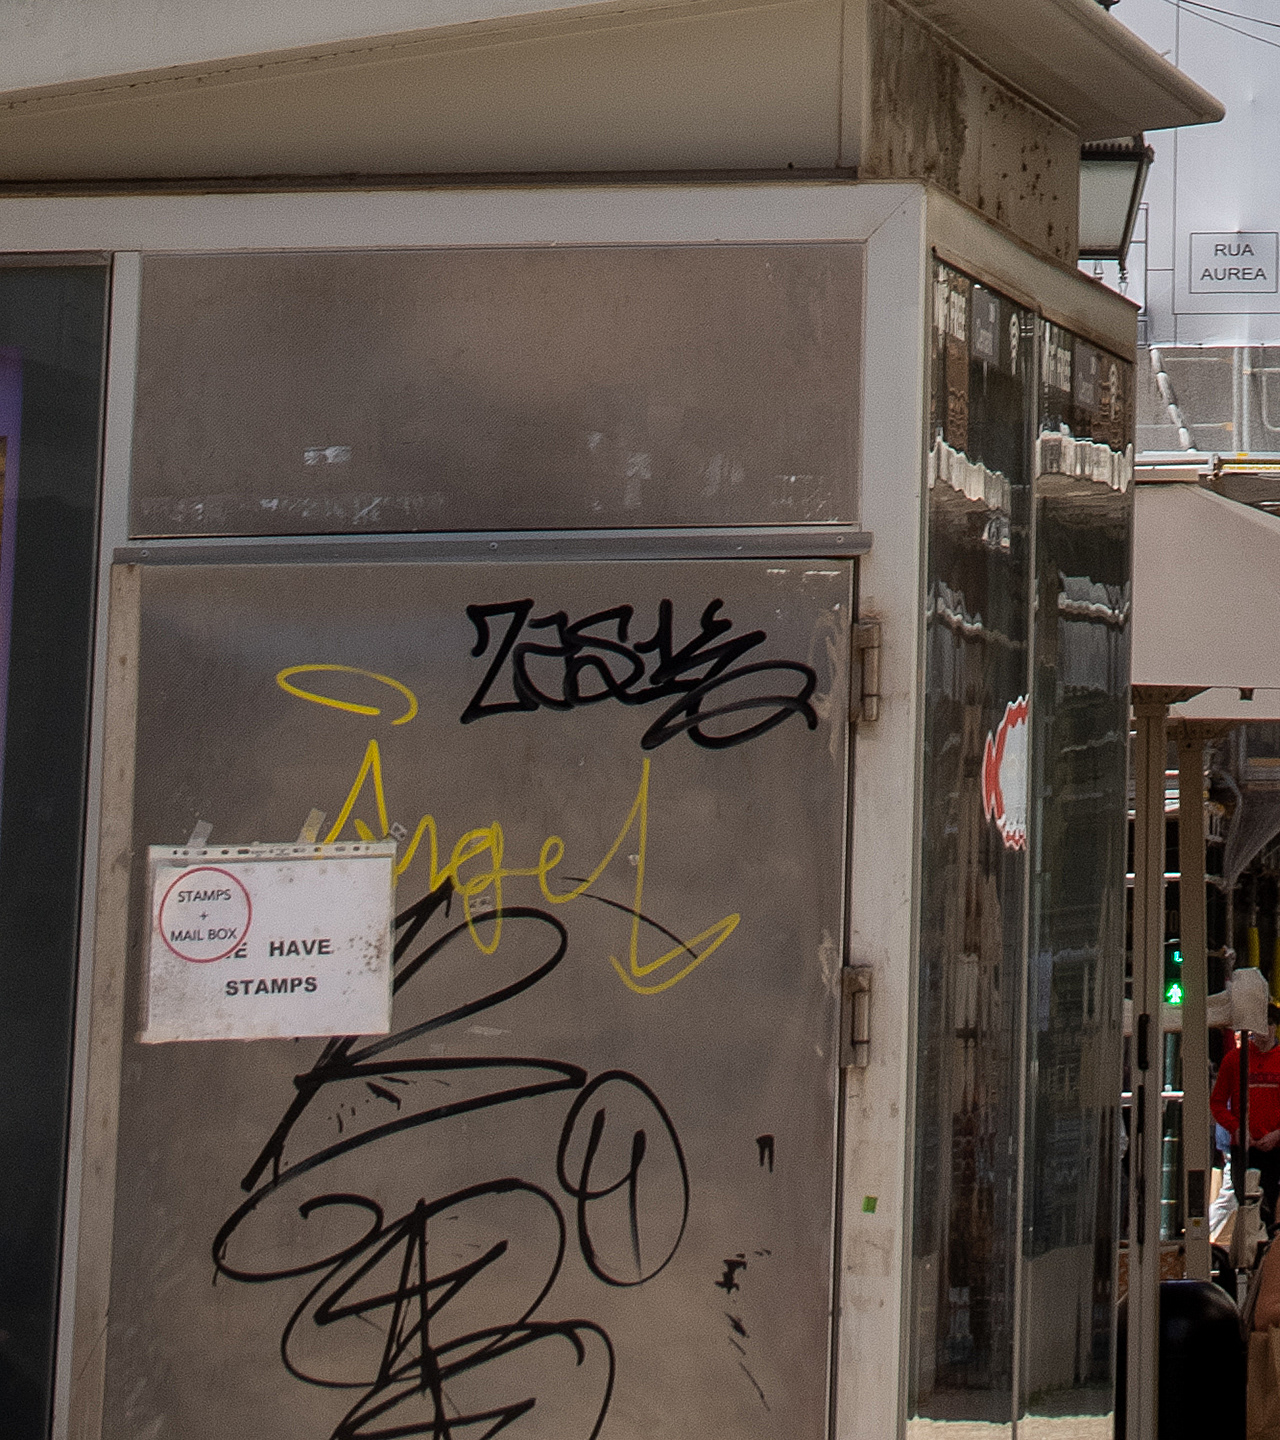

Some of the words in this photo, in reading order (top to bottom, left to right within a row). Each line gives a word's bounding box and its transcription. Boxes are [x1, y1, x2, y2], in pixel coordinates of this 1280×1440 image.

[1214, 243, 1255, 257] RUA
[1200, 267, 1267, 281] AUREA
[177, 888, 232, 904] STAMPS
[170, 929, 204, 942] MAIL
[207, 927, 238, 941] BOX
[226, 941, 248, 959] E
[269, 938, 332, 959] HAVE
[225, 976, 319, 997] STAMPS
